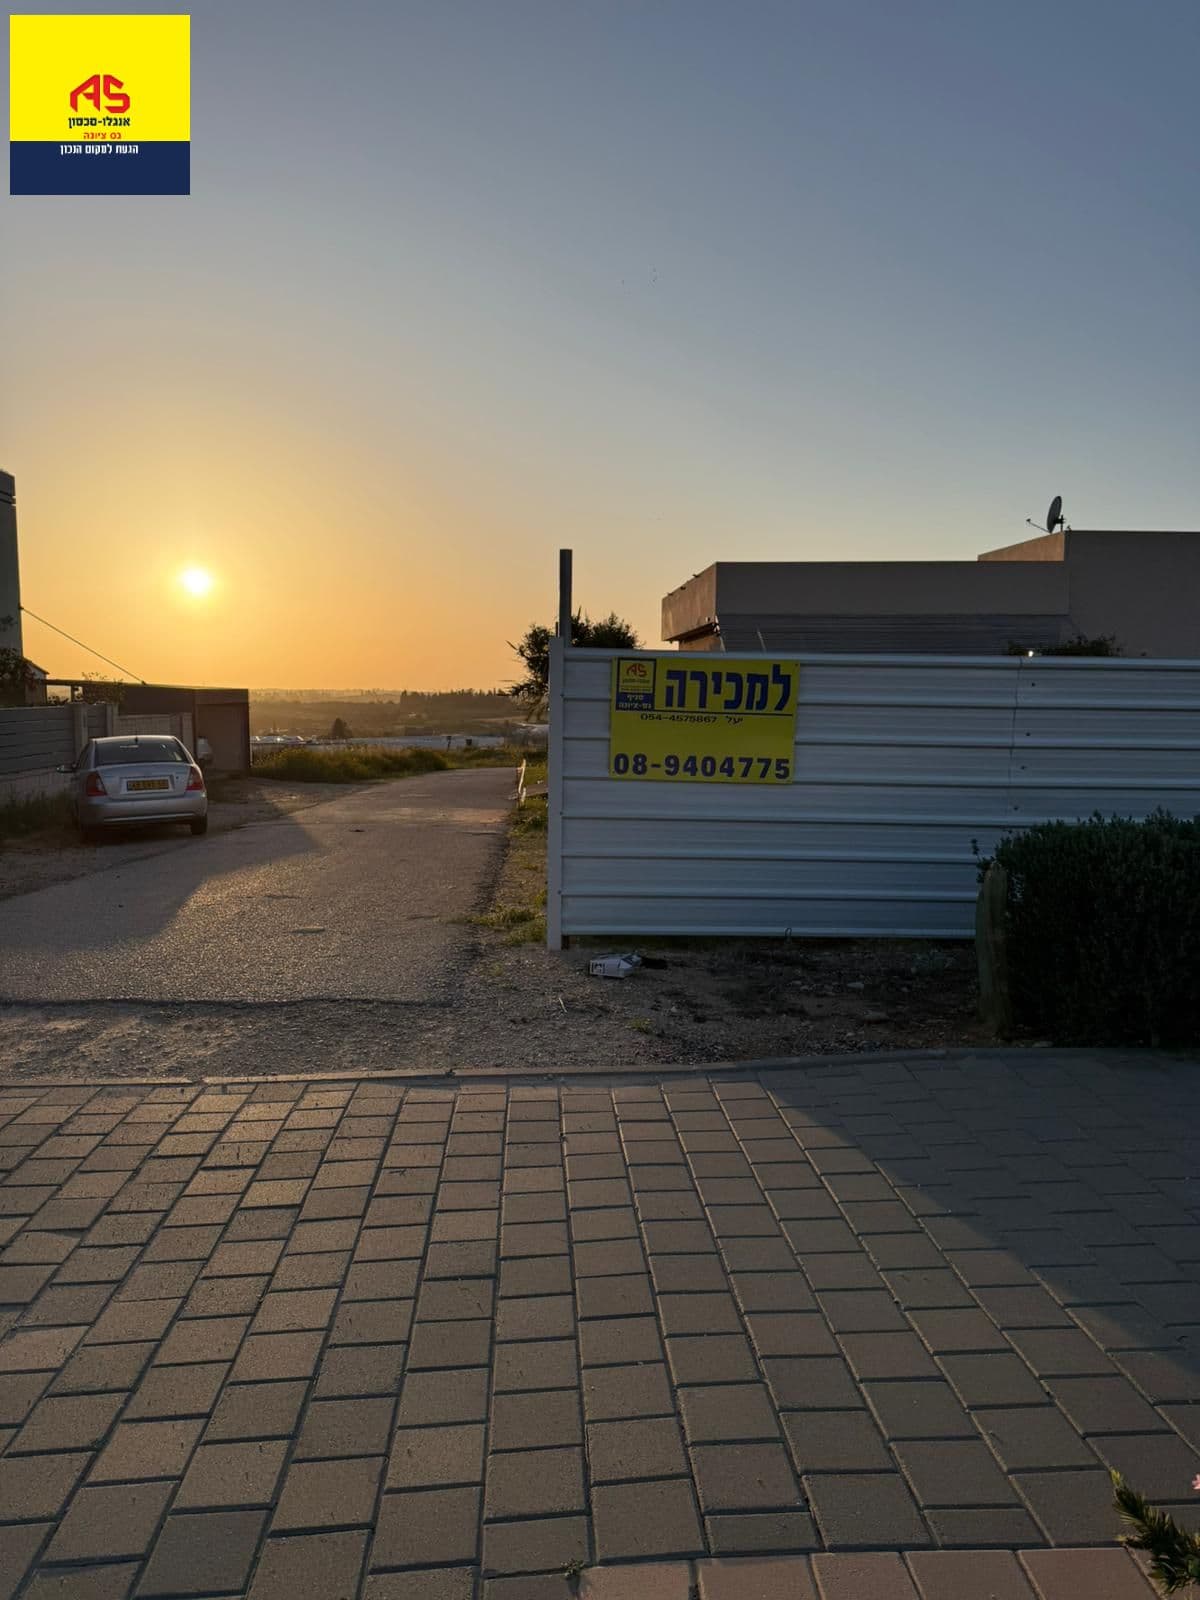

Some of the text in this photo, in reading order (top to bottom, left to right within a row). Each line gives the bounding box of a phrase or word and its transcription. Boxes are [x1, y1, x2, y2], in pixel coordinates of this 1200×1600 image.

[665, 664, 792, 711] למכירה
[640, 713, 717, 724] 054-4575867
[613, 753, 790, 780] 08-9404775
